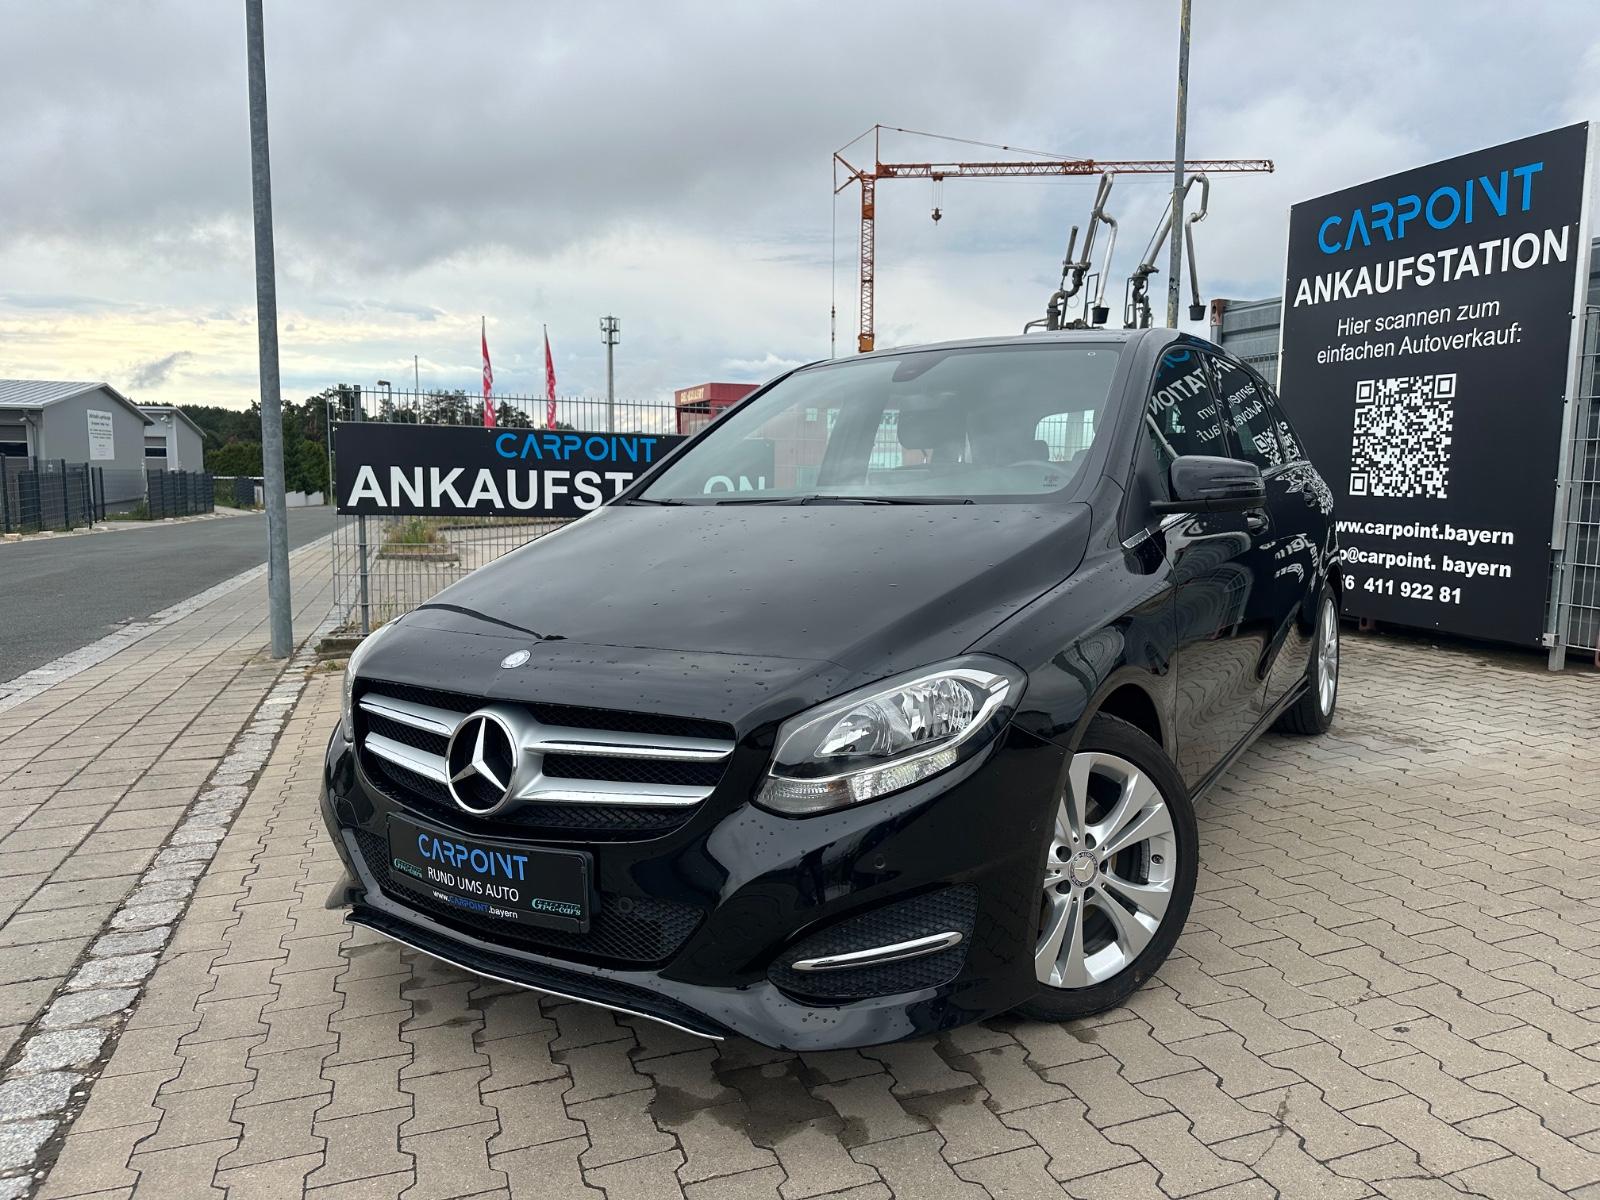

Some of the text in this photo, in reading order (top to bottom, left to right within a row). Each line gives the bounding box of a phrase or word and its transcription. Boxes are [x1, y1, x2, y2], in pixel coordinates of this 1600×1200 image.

[1317, 161, 1544, 255] CARPOINT
[1293, 225, 1571, 308] ANKAUFSTATION
[1336, 299, 1501, 337] Hier scannen zum
[1316, 322, 1522, 364] einfachen Autoverkauf:
[495, 432, 657, 463] CARPOINT
[1335, 520, 1514, 546] ww.carpoint.bayern
[1340, 546, 1437, 570] o@carpoint.
[1442, 555, 1512, 578] bayern
[1343, 574, 1462, 605] 6 411 922 81
[418, 833, 528, 881] CARPOINT
[427, 866, 455, 887] RUND
[457, 875, 483, 894] UMS
[485, 884, 519, 902] AUTO
[432, 889, 518, 919] www.CARPOINT.bayern
